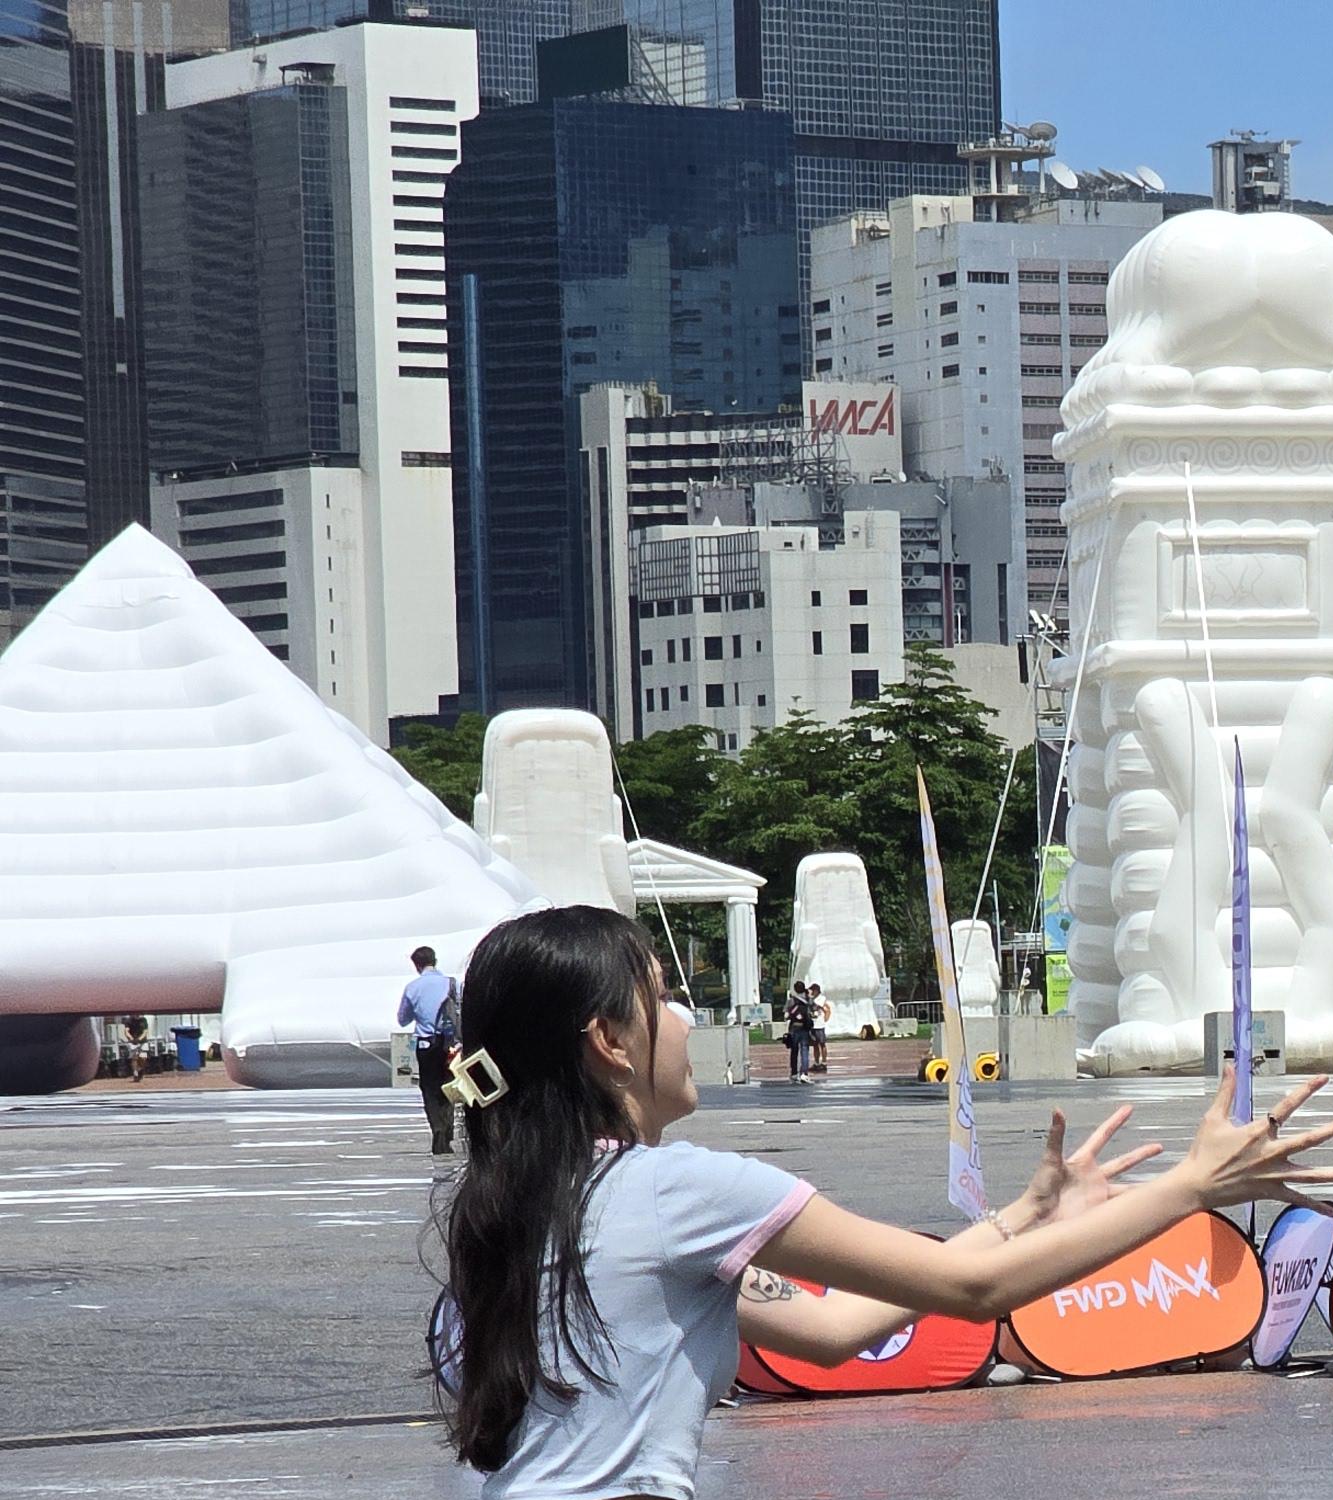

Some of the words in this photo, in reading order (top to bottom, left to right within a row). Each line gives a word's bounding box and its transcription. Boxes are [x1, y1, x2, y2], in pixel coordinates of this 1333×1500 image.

[809, 387, 895, 445] YMCA
[1053, 1280, 1127, 1318] FWD
[1130, 1256, 1221, 1315] MAX
[1270, 1257, 1318, 1297] FUNKIDS
